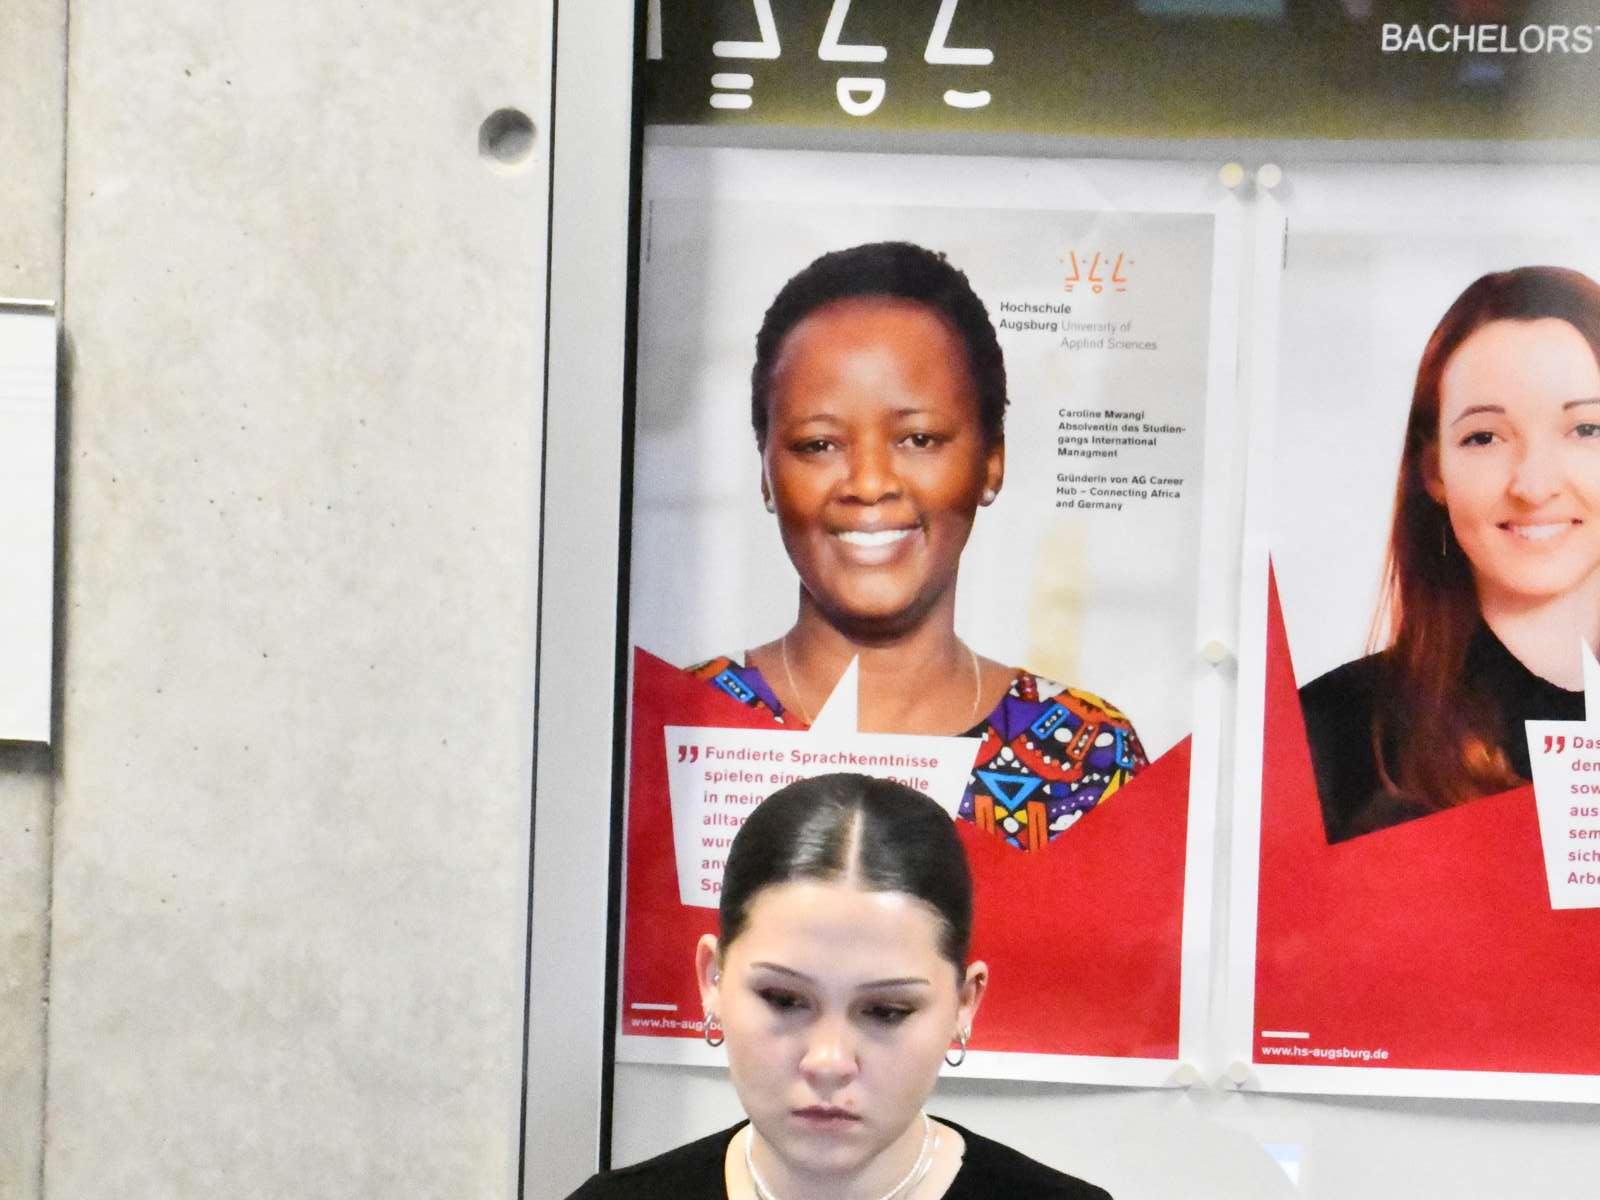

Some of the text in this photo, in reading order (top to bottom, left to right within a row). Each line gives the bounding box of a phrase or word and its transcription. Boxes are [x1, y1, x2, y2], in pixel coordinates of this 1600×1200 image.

[1000, 302, 1072, 314] Hochschule
[999, 318, 1132, 334] Augsburg University of
[1060, 337, 1158, 350] Applied Sciences
[1058, 408, 1145, 421] Caroline Mwangi
[1058, 422, 1187, 434] Absolventin des Studien-
[1057, 435, 1157, 446] gangs International
[1056, 473, 1184, 486] Gründerin von AG Career
[1056, 486, 1077, 495] Hub
[1089, 487, 1148, 499] Connecting
[1150, 488, 1181, 498] Africa
[1055, 500, 1123, 511] and Germany
[705, 746, 939, 769] Fundierte Sprachkenntnisse
[704, 769, 764, 784] spielen
[704, 790, 718, 803] in
[1569, 806, 1599, 817] aus
[1261, 1046, 1389, 1061] www.hs-augsburg.de
